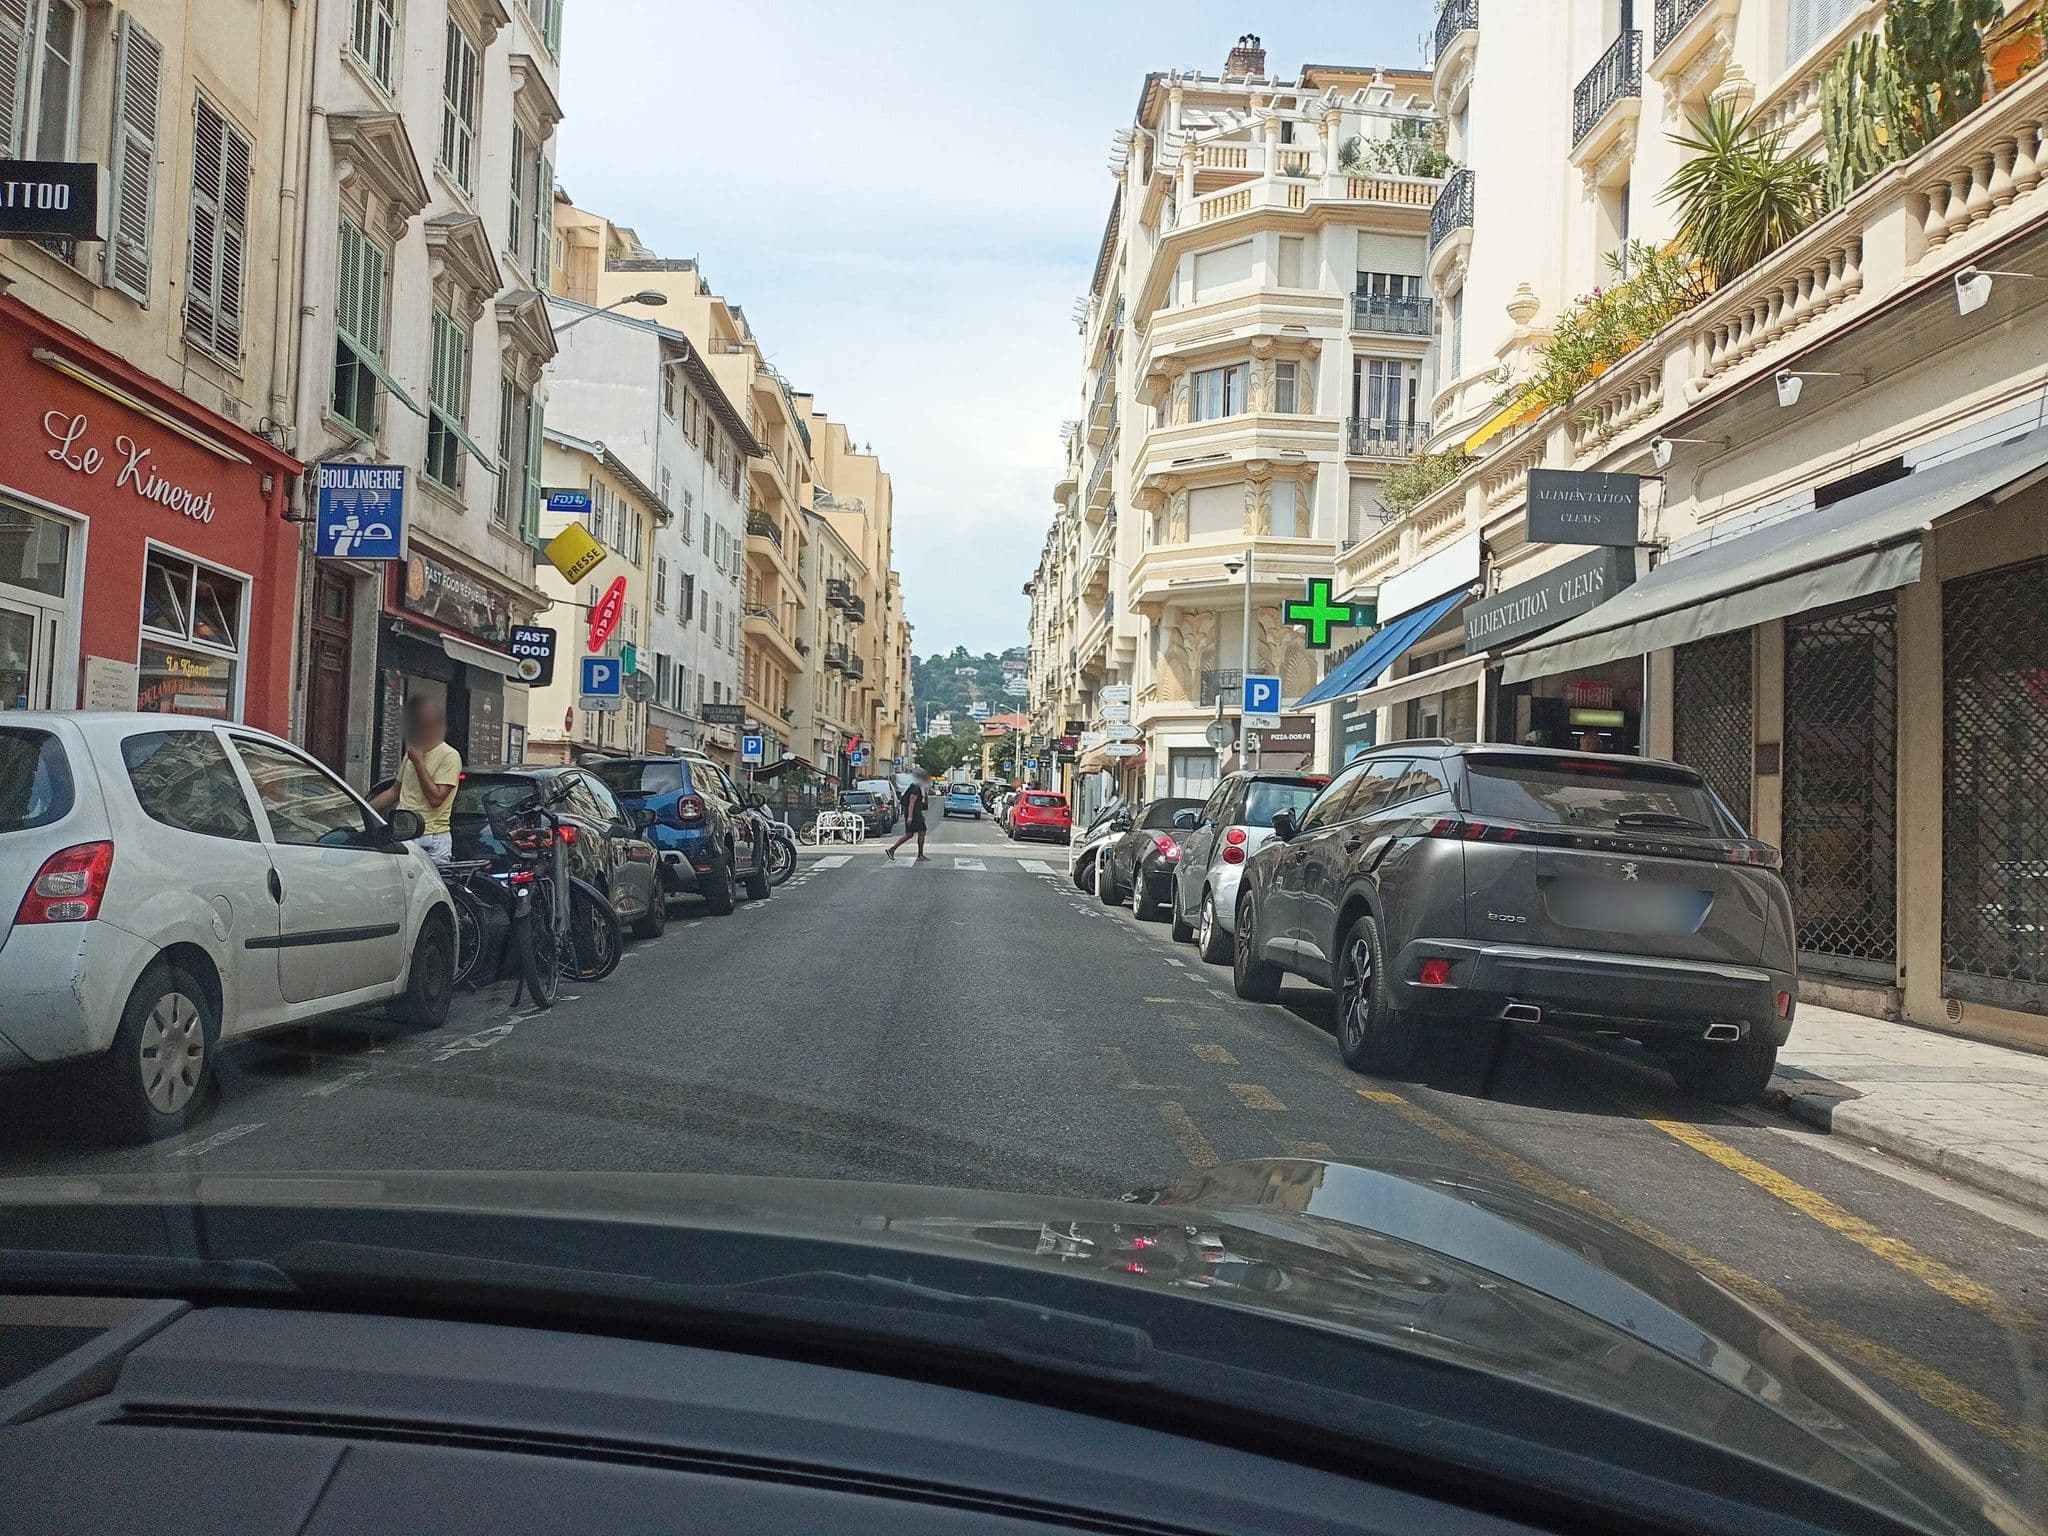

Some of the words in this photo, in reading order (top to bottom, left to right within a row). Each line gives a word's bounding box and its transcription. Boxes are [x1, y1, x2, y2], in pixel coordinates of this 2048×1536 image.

[0, 181, 70, 210] TTOO
[44, 410, 104, 475] Le
[115, 435, 216, 524] Kineret
[320, 469, 402, 490] BOULANGERIE
[553, 495, 574, 505] FDJ
[1536, 489, 1633, 505] ALIMENTATION
[567, 547, 600, 579] PRESSE
[425, 565, 442, 585] FAST
[442, 575, 460, 594] FOOD
[596, 590, 620, 637] TABAC
[1467, 588, 1550, 641] ALIMENTATION
[1559, 566, 1604, 605] CLEM'S
[515, 631, 550, 643] FAST
[512, 644, 550, 657] FOOD
[166, 655, 179, 672] Le
[592, 664, 610, 689] P
[1253, 683, 1270, 707] P
[747, 741, 757, 752] P
[1576, 837, 1685, 853] PEUGEOT
